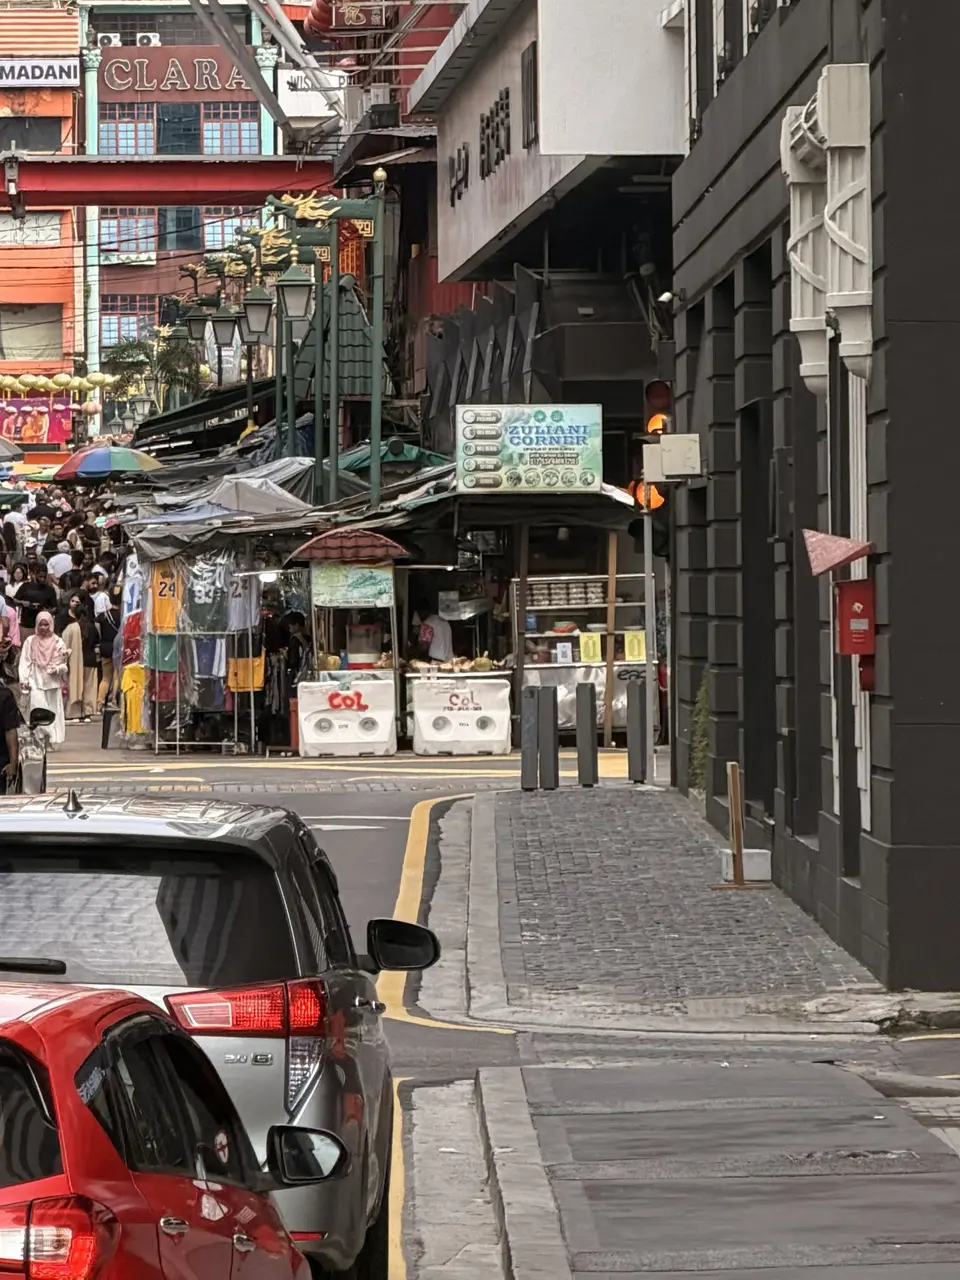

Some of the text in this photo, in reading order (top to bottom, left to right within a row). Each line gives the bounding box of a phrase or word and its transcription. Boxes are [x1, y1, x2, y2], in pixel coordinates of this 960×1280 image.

[0, 64, 78, 81] MADANI
[104, 57, 253, 92] CLARA
[508, 425, 589, 435] ZULIANI
[509, 435, 589, 446] CORNER
[158, 581, 176, 598] 24
[328, 691, 369, 712] COL
